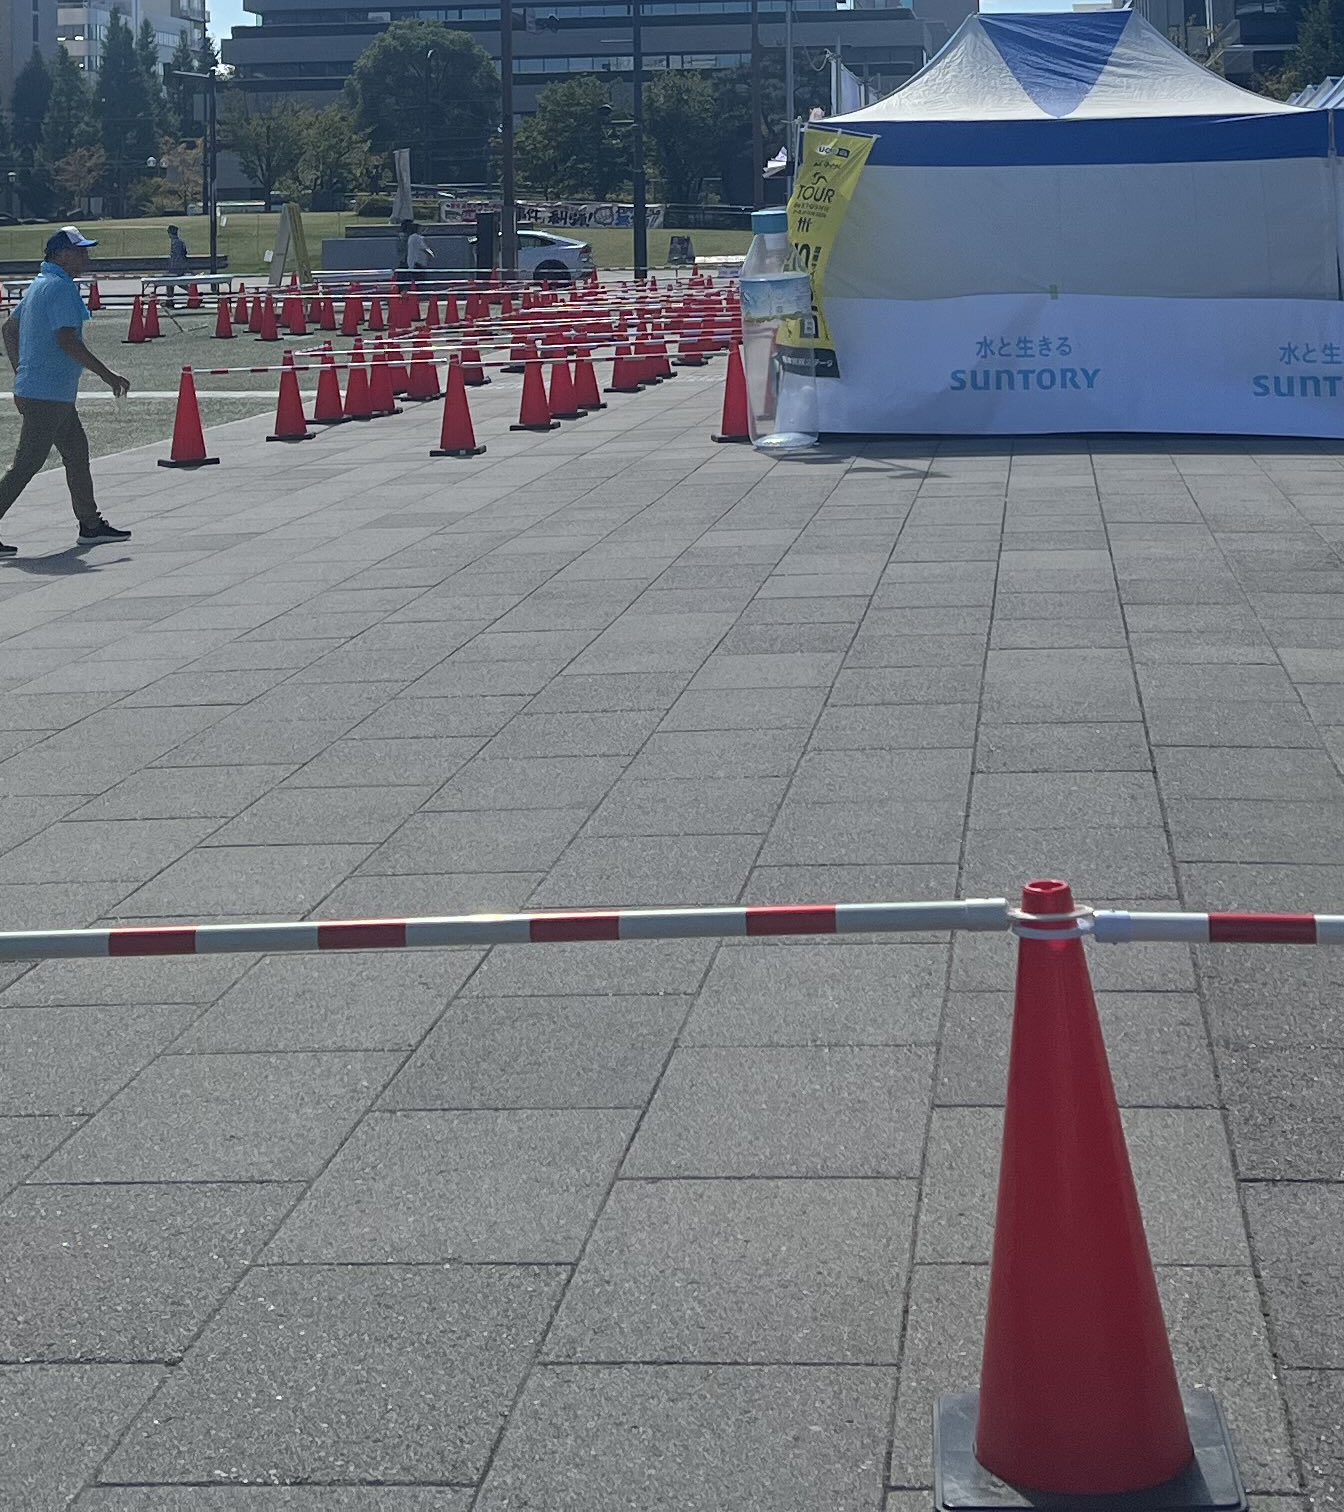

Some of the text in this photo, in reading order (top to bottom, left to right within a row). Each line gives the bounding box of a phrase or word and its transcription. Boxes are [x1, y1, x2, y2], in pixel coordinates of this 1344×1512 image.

[796, 184, 836, 204] TOUR
[975, 335, 1073, 359] 水と生きる
[949, 367, 1102, 391] SUNTORY
